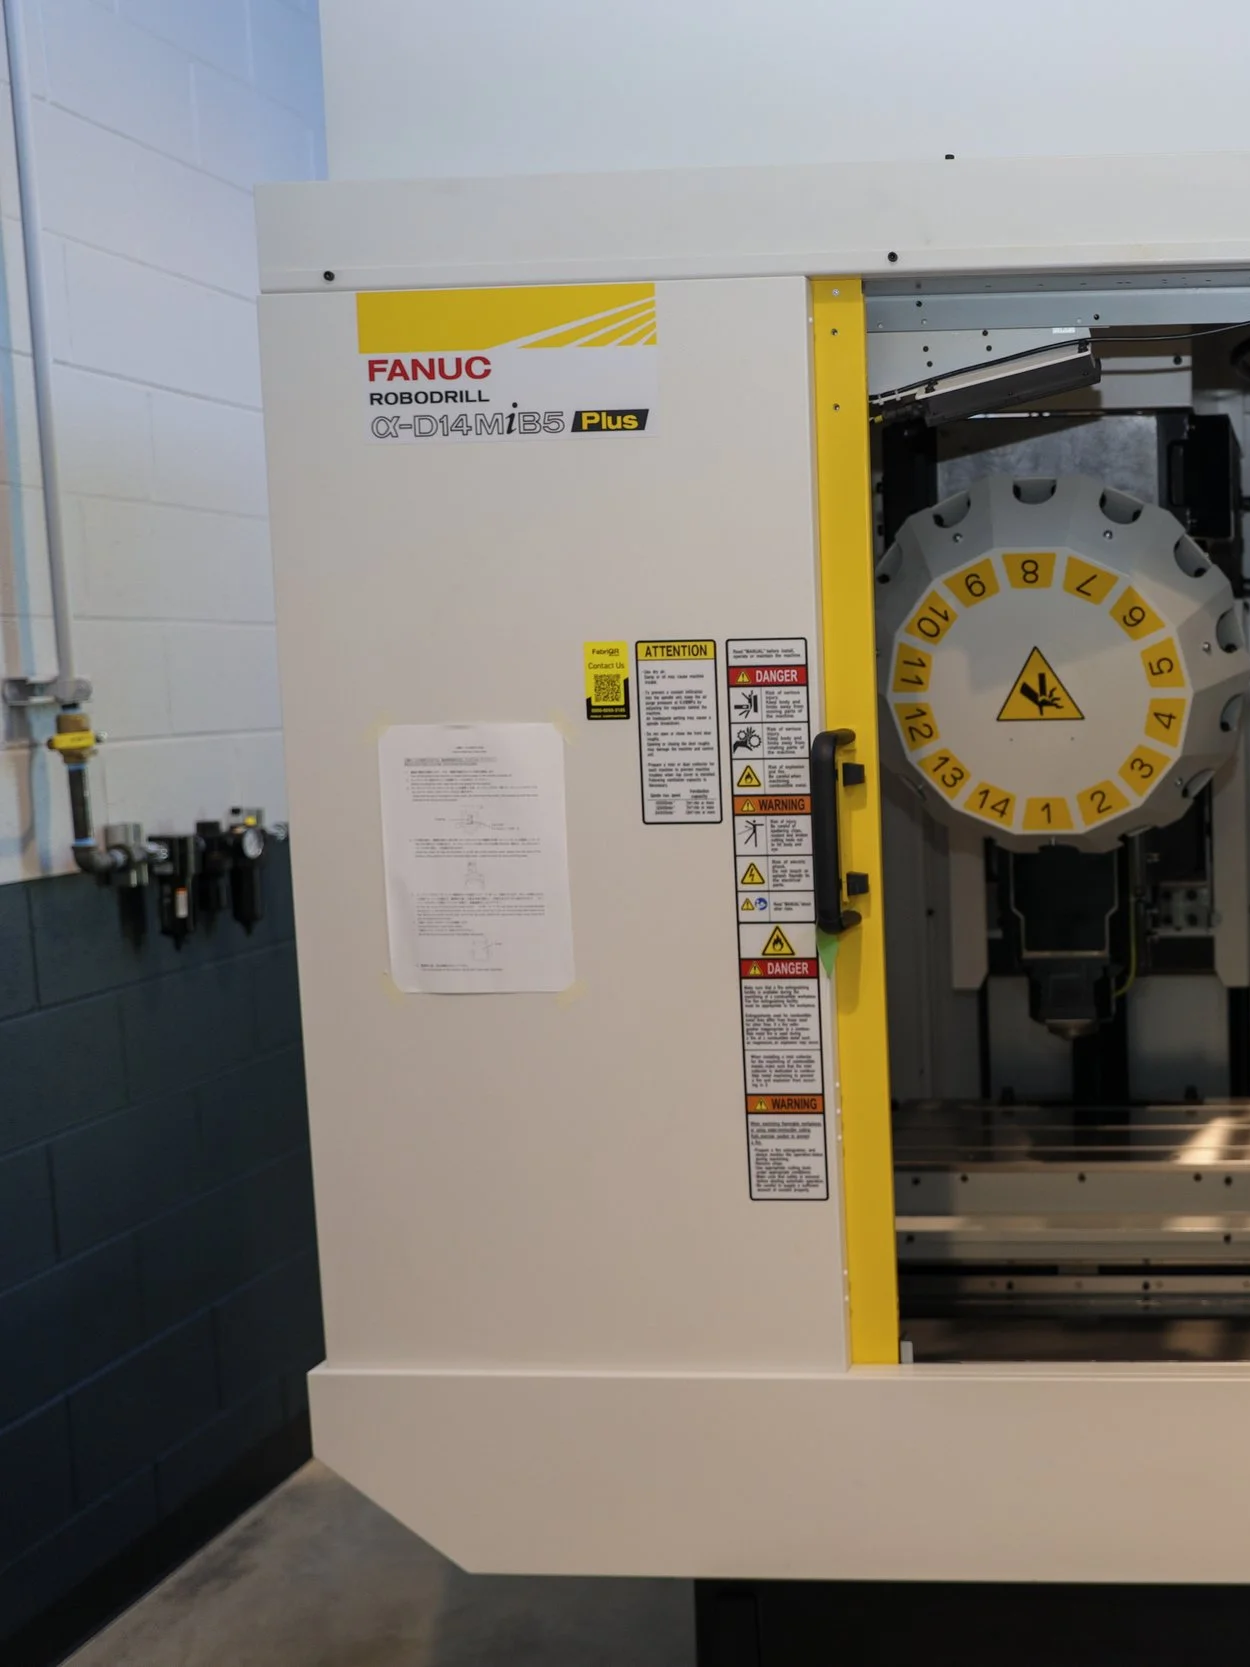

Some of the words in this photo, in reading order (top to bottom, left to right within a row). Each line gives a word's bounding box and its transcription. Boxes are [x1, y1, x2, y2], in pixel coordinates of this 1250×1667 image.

[368, 356, 491, 382] FANUC
[370, 390, 490, 406] ROBODRILL
[581, 411, 638, 430] Plus
[1021, 559, 1039, 584] 8
[1076, 573, 1098, 596] 7
[916, 605, 949, 638] 10
[645, 645, 707, 657] ATTENTION
[756, 670, 798, 682] DANGER
[903, 656, 926, 687] 11
[1149, 656, 1174, 676] 5
[905, 708, 934, 741] 12
[1153, 711, 1176, 729] 4
[932, 755, 964, 788] 13
[1130, 757, 1154, 779] 3
[759, 799, 805, 810] WARNING
[978, 788, 1010, 816] 14
[1090, 790, 1112, 814] 2
[1041, 803, 1051, 824] 1
[768, 962, 808, 974] DANGER
[772, 1098, 817, 1110] WARNING
